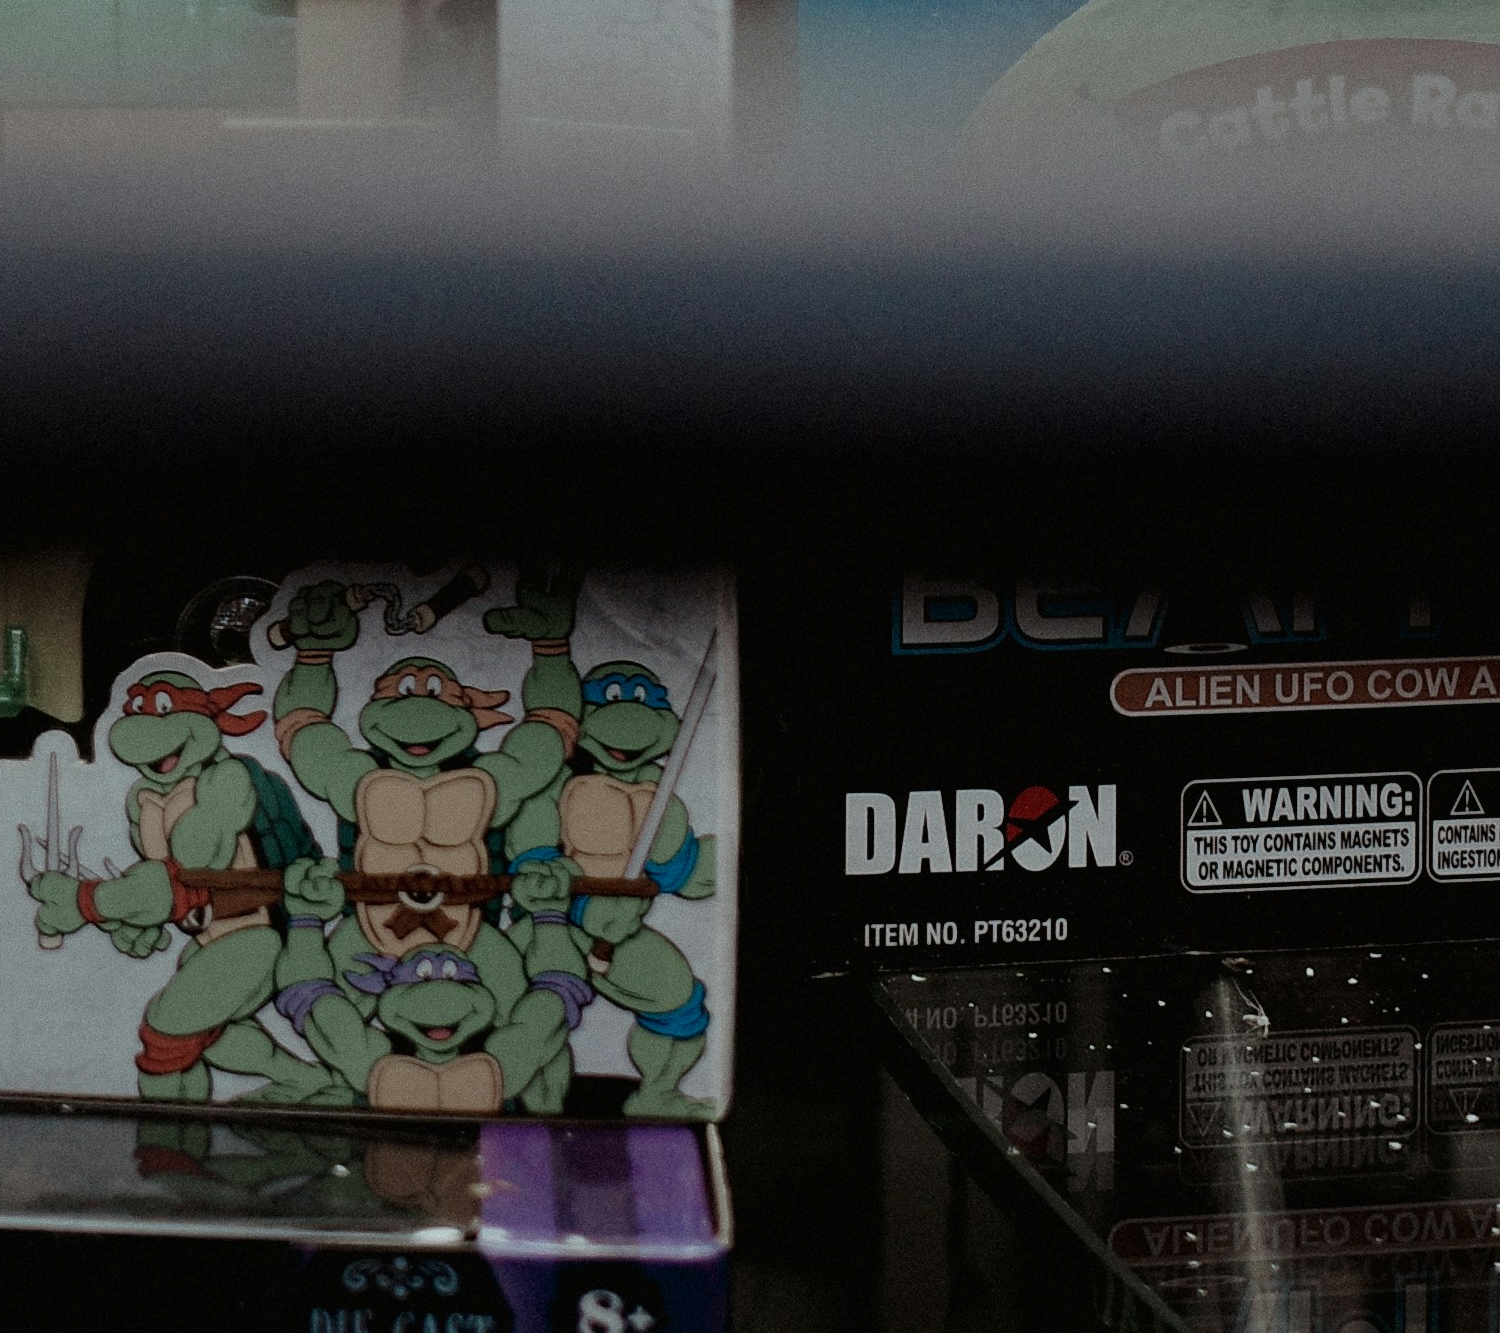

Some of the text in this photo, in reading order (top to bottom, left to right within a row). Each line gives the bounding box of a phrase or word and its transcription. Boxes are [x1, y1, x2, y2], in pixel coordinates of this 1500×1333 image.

[1143, 673, 1261, 710] ALIEN
[1273, 669, 1356, 705] UFO
[1365, 664, 1460, 701] COW
[1241, 781, 1413, 824] WARNING:
[1193, 827, 1410, 856] THIS TOY CONTAINS MAGNETS
[1437, 822, 1496, 845] CONTAINS
[1197, 853, 1405, 881] OR MAGNETIC COMPONENTS.
[863, 917, 1069, 947] ITEM NO. PT63210
[576, 1287, 657, 1333] 8+
